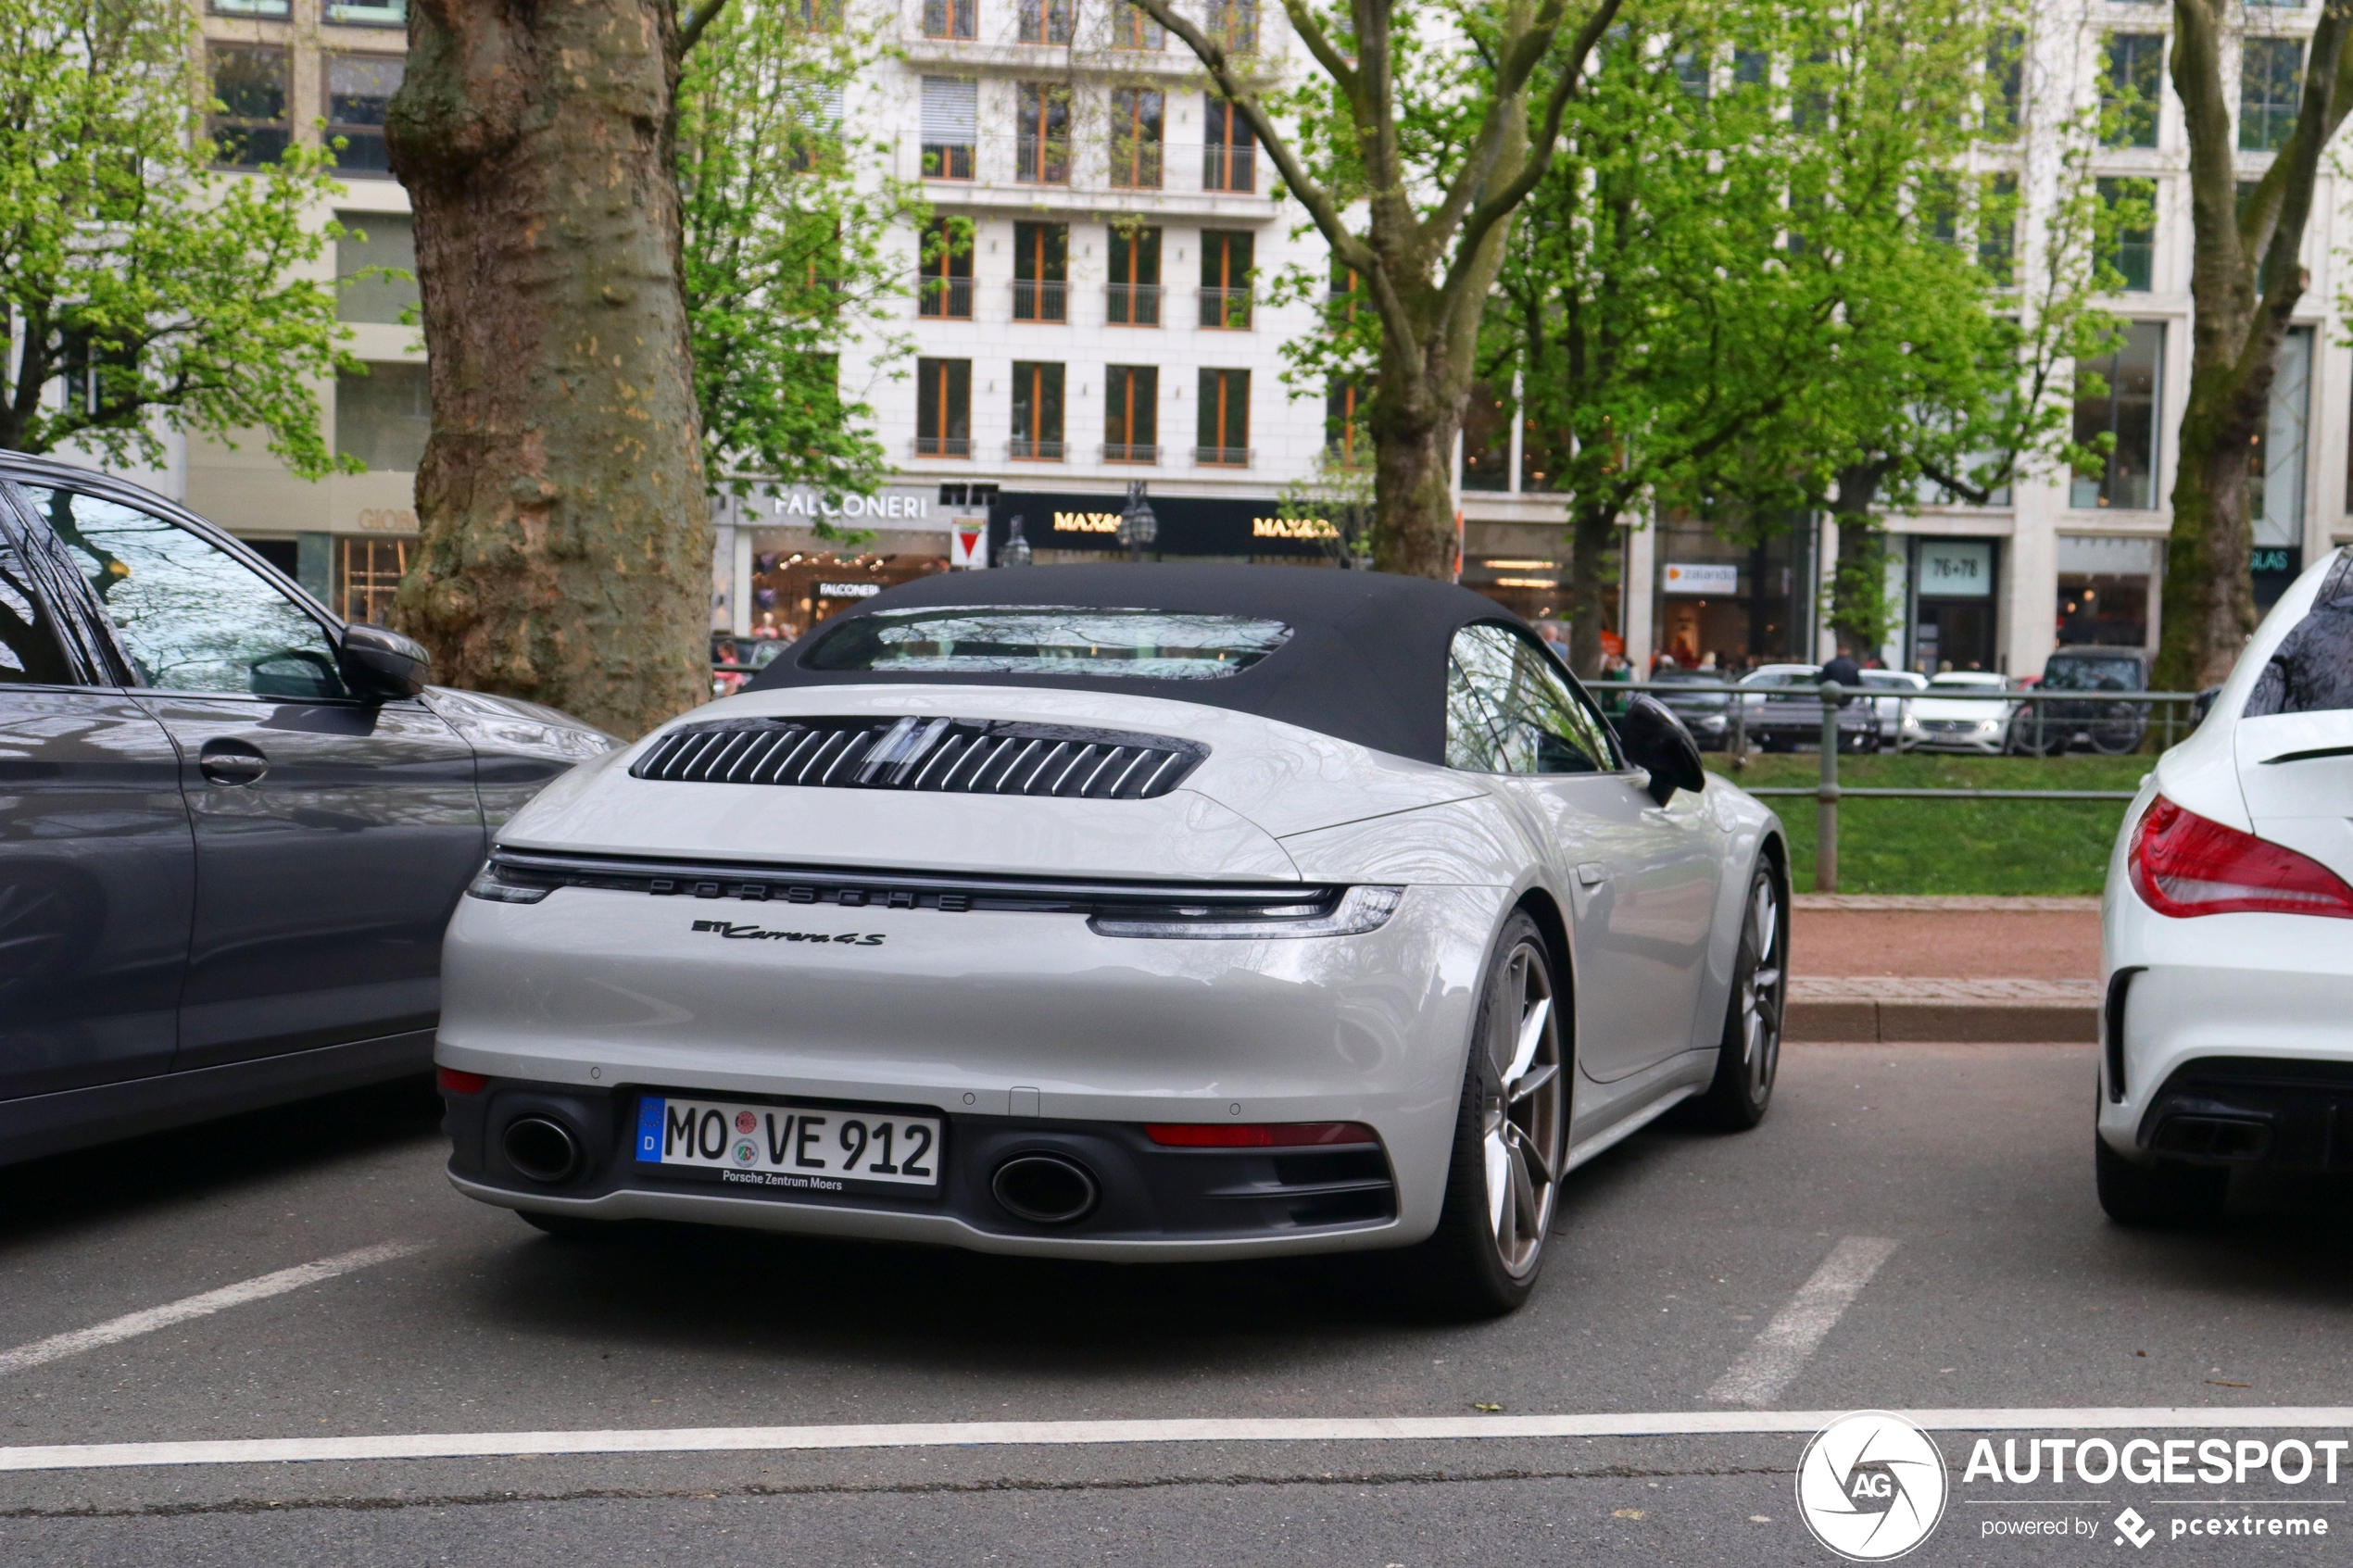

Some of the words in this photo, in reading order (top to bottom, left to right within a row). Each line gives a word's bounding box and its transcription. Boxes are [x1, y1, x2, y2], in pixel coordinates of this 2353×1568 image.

[820, 583, 880, 597] FALCONERI
[650, 880, 969, 912] PORSCHE
[722, 925, 830, 943] Carrera
[644, 1135, 655, 1150] D
[664, 1105, 728, 1160] MO
[765, 1113, 826, 1168] VE
[839, 1119, 932, 1177] 912
[723, 1169, 763, 1184] Porsche
[765, 1173, 808, 1187] Zentrum
[810, 1176, 842, 1191] Moers
